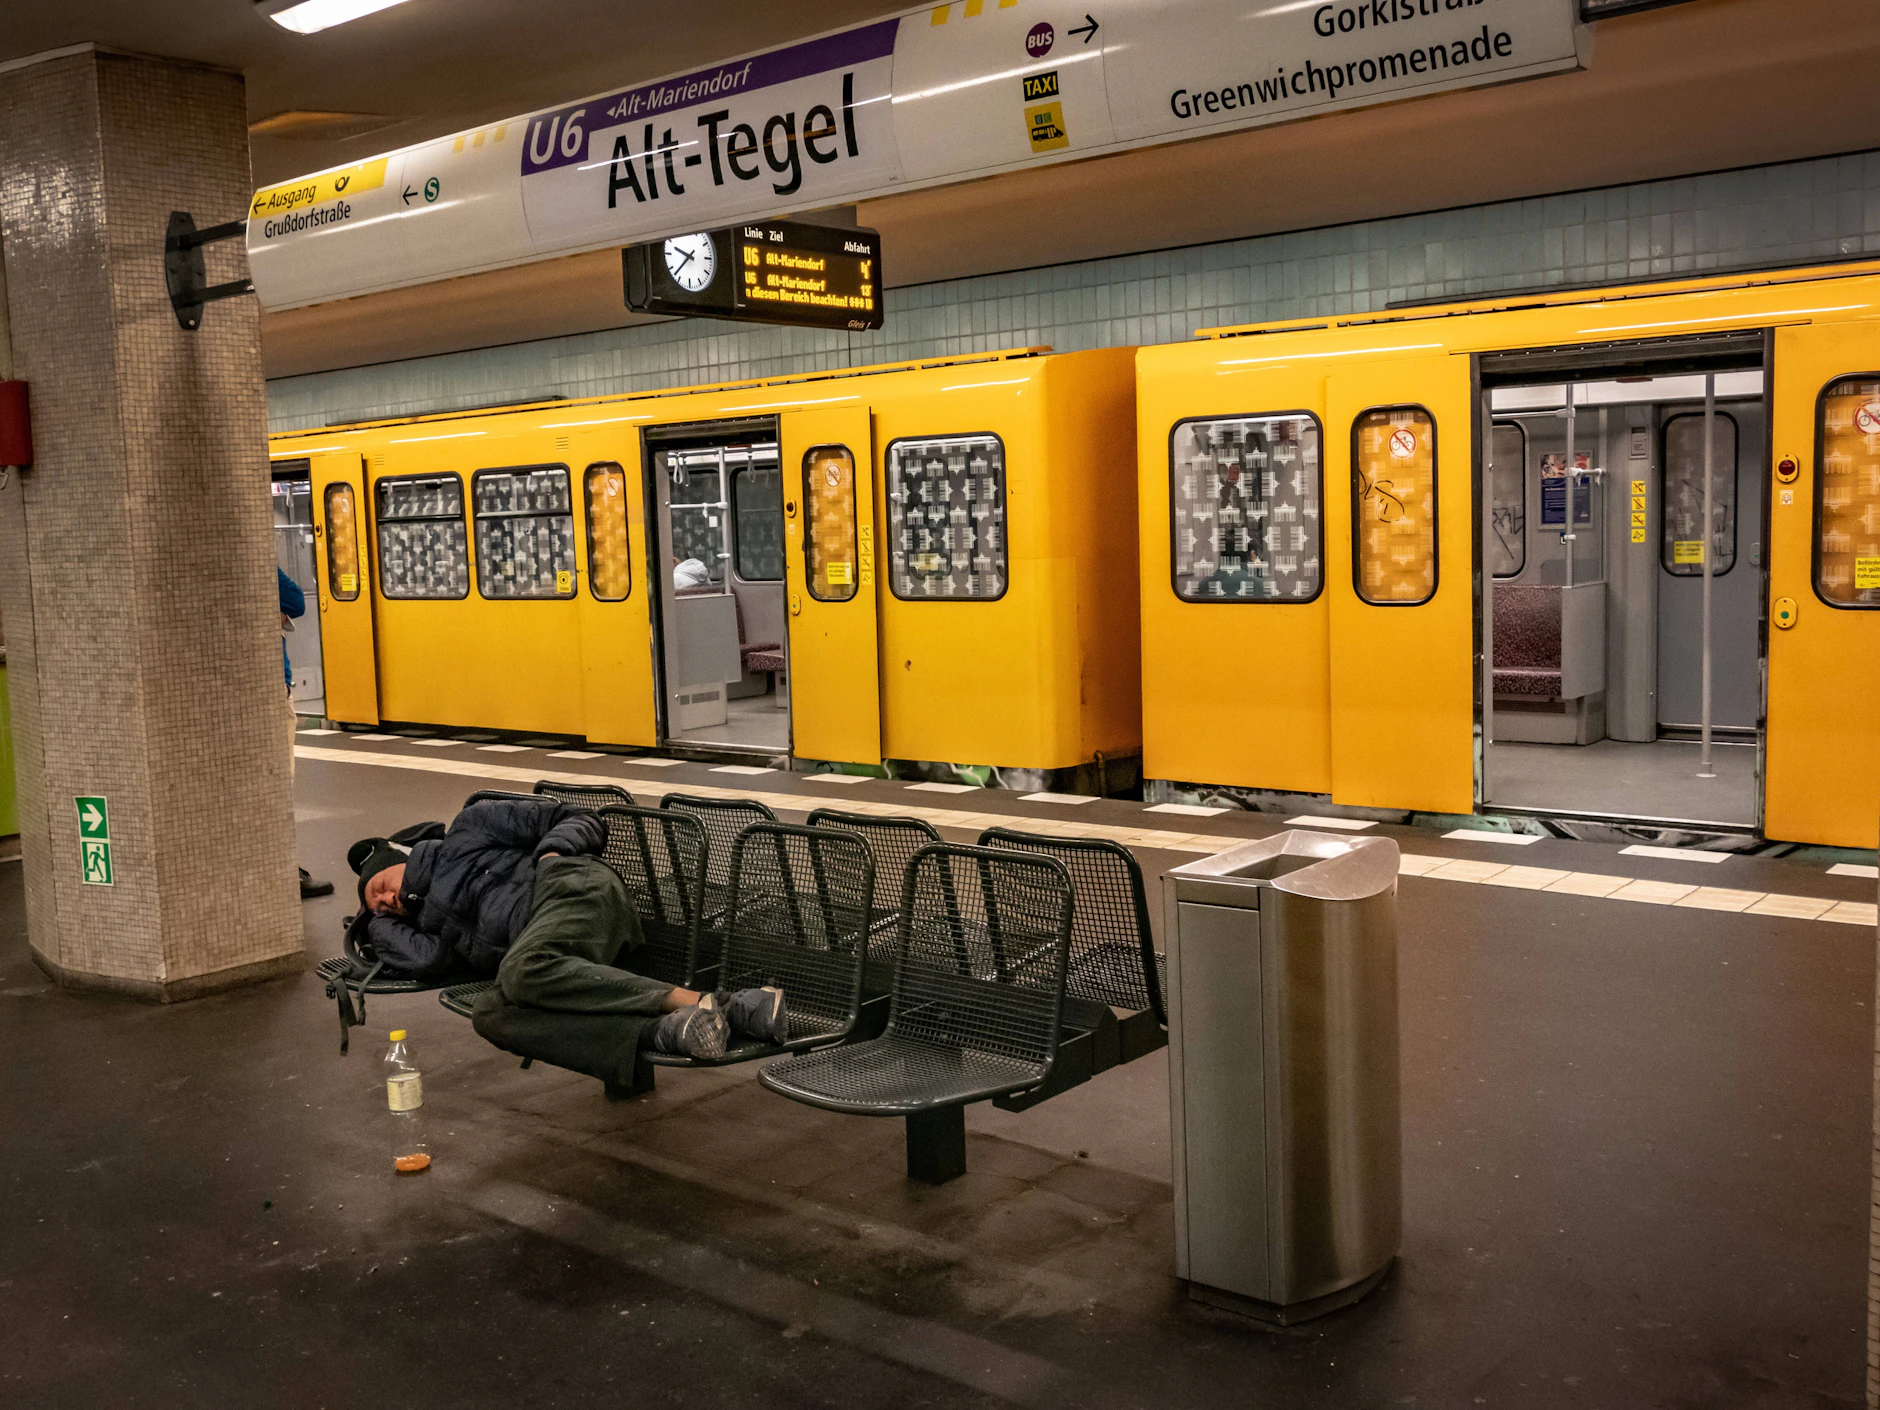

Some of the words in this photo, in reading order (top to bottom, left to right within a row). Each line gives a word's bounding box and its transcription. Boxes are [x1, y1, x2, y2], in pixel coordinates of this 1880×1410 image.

[1313, 0, 1500, 37] Gorkistra
[1027, 31, 1053, 50] BUS
[1170, 25, 1513, 119] Greenwichpromenade
[614, 61, 753, 118] Alt-Mariendorf
[1024, 75, 1057, 97] TAXI
[529, 108, 587, 165] U6
[608, 72, 859, 209] Alt-Tegel
[267, 184, 317, 210] Ausgang
[264, 200, 352, 238] Grußdorfstraße
[744, 226, 764, 240] Linie
[769, 230, 784, 243] Ziel
[844, 241, 871, 255] Abfahrt
[743, 246, 760, 266] U6
[766, 252, 826, 271] Alt-Mariendorf
[744, 271, 757, 284] U6
[766, 273, 826, 292] Alt-Mariendorf
[779, 289, 810, 304] Bereich
[848, 319, 866, 329] Gleis
